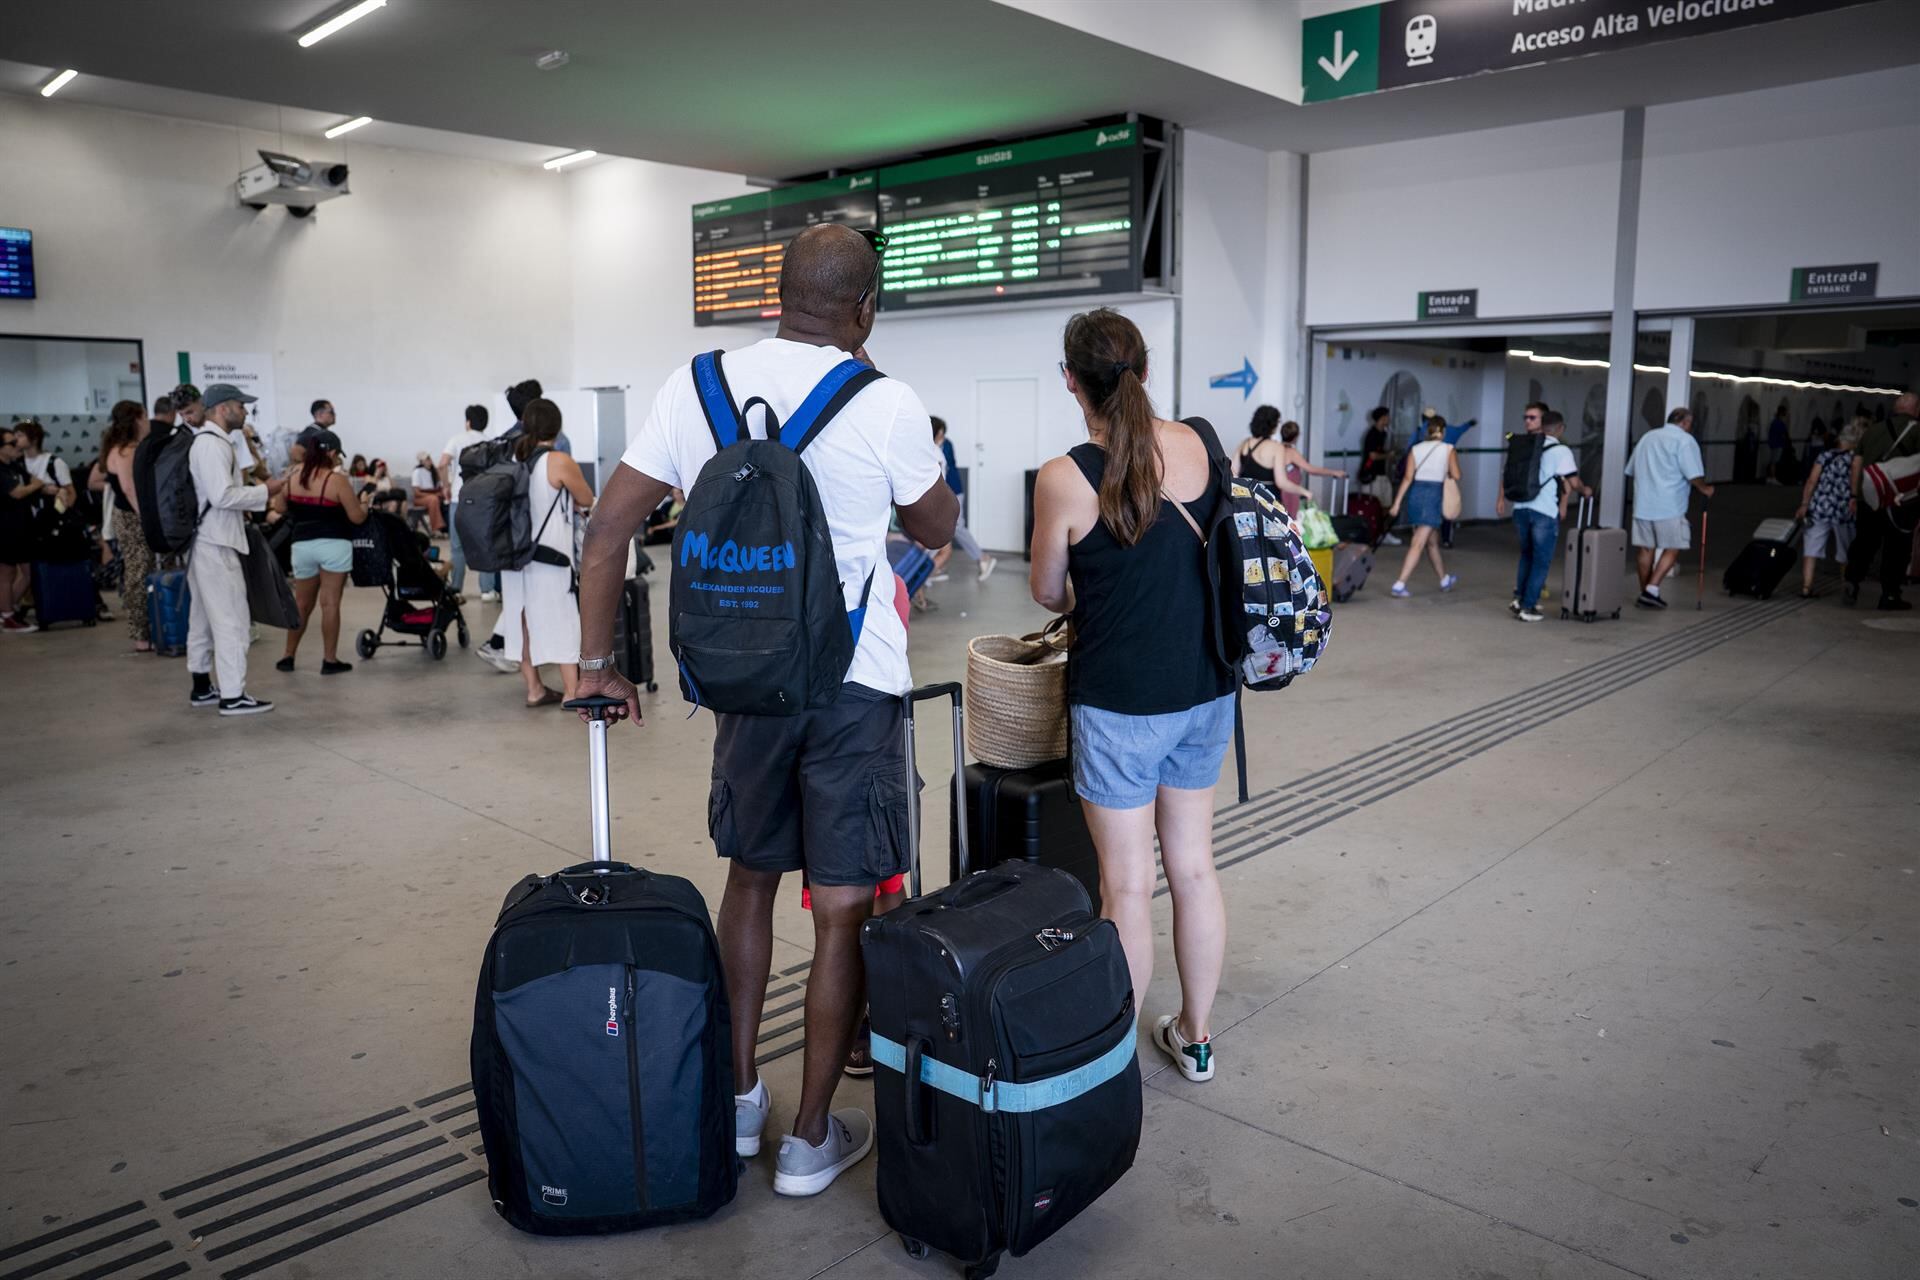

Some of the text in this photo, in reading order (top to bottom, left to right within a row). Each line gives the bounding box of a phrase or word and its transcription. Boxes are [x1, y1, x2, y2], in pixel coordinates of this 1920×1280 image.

[1511, 0, 1774, 54] Acceso Alta Velocida
[1808, 270, 1867, 284] Entrada
[1807, 284, 1851, 294] ENTRANCE
[1428, 294, 1470, 306] Entrada
[690, 581, 745, 593] ALEXANDER
[719, 600, 760, 609] EST. 1992
[608, 987, 618, 1021] berghaus
[541, 1185, 568, 1195] PRIME
